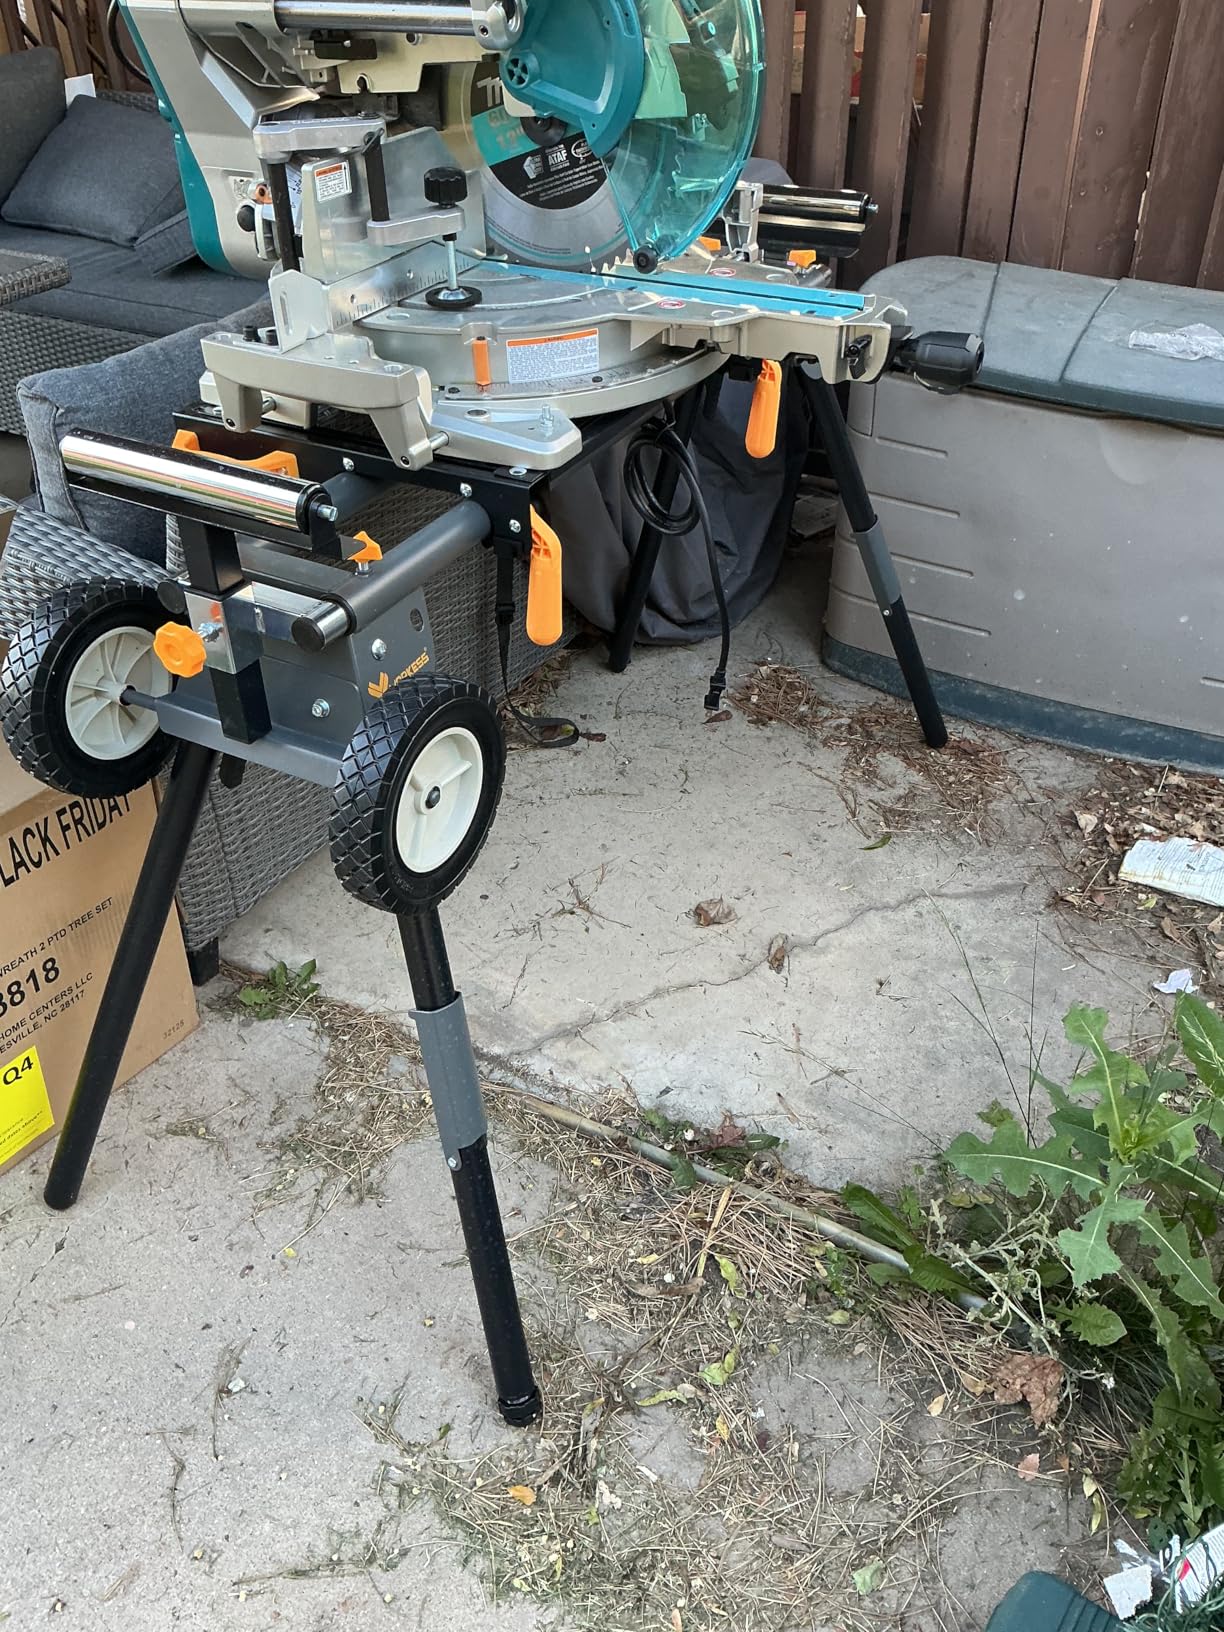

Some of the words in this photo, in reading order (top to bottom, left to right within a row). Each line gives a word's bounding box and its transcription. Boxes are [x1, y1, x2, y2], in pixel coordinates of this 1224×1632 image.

[548, 150, 567, 165] ATAF
[39, 942, 46, 951] 2
[47, 928, 67, 946] PTD
[69, 911, 94, 932] TREE
[95, 897, 113, 914] SET
[29, 986, 74, 1021] CENTERS
[75, 972, 93, 989] LLC
[44, 1009, 58, 1023] NC
[60, 990, 85, 1012] 28117
[3, 1055, 34, 1085] Q4
